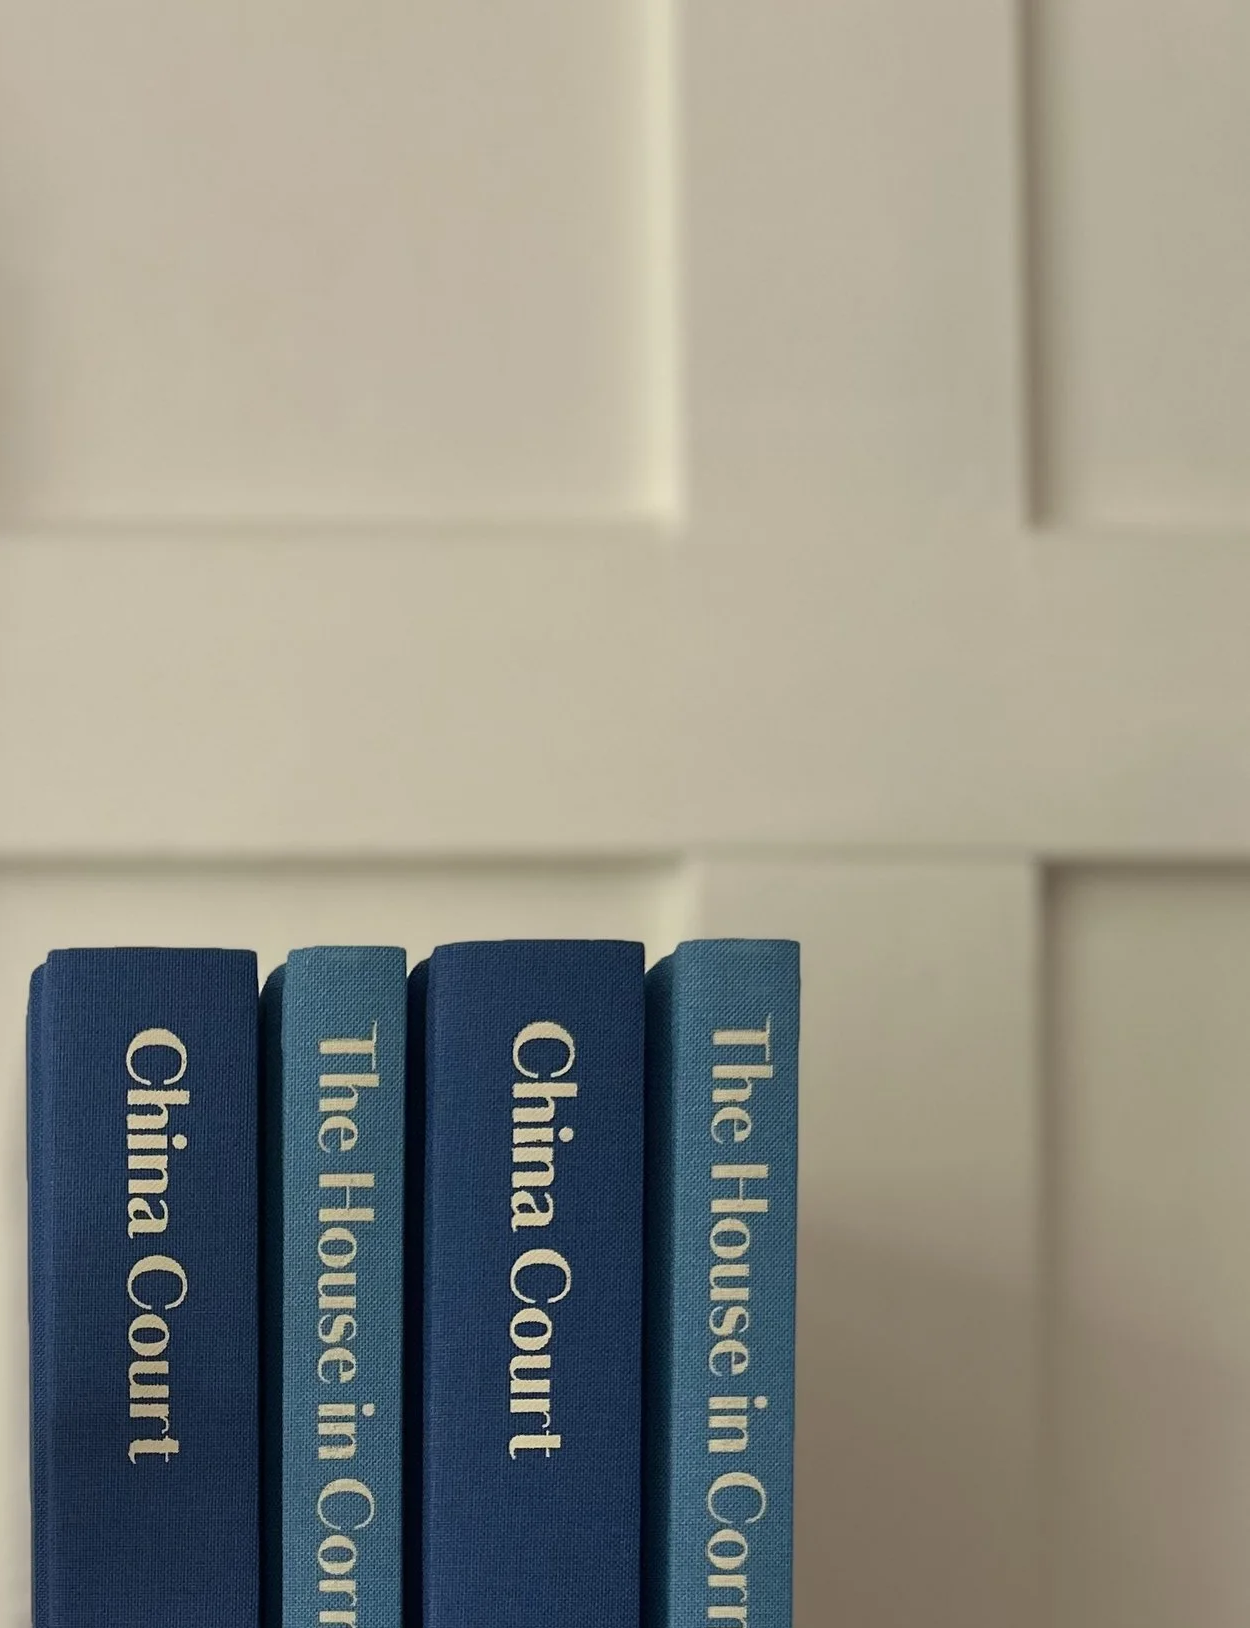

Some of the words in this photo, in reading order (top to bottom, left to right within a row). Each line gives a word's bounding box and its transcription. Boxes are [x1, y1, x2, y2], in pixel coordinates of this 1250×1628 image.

[125, 1028, 190, 1239] China
[318, 1022, 380, 1152] The
[510, 1021, 578, 1232] China
[710, 1015, 774, 1143] The
[127, 1255, 188, 1464] Court
[317, 1173, 376, 1384] House
[508, 1248, 572, 1460] Court
[708, 1163, 770, 1375] House
[317, 1403, 376, 1461] in
[708, 1395, 769, 1454] in
